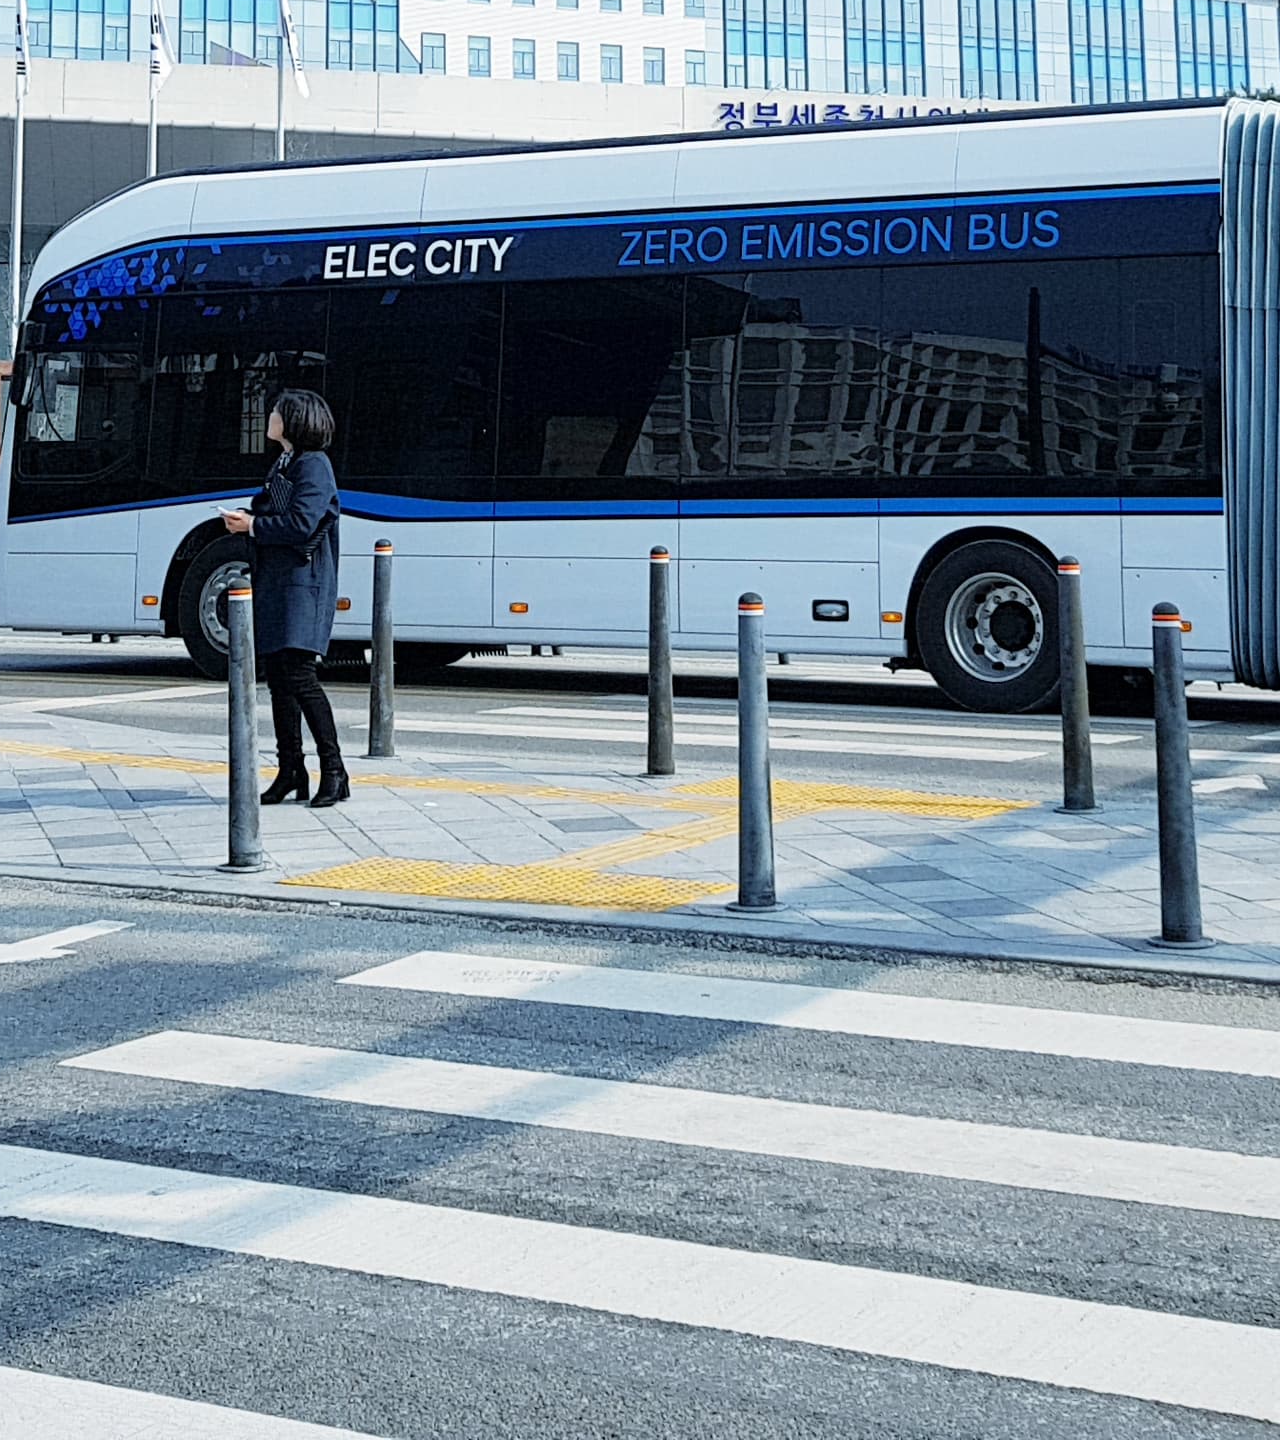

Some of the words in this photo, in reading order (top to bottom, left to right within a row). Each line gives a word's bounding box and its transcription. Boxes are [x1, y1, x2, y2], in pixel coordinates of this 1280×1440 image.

[323, 241, 417, 279] ELEC
[424, 236, 514, 275] CITY
[619, 226, 728, 266] ZERO
[741, 215, 952, 260] EMISSION
[967, 209, 1060, 251] BUS
